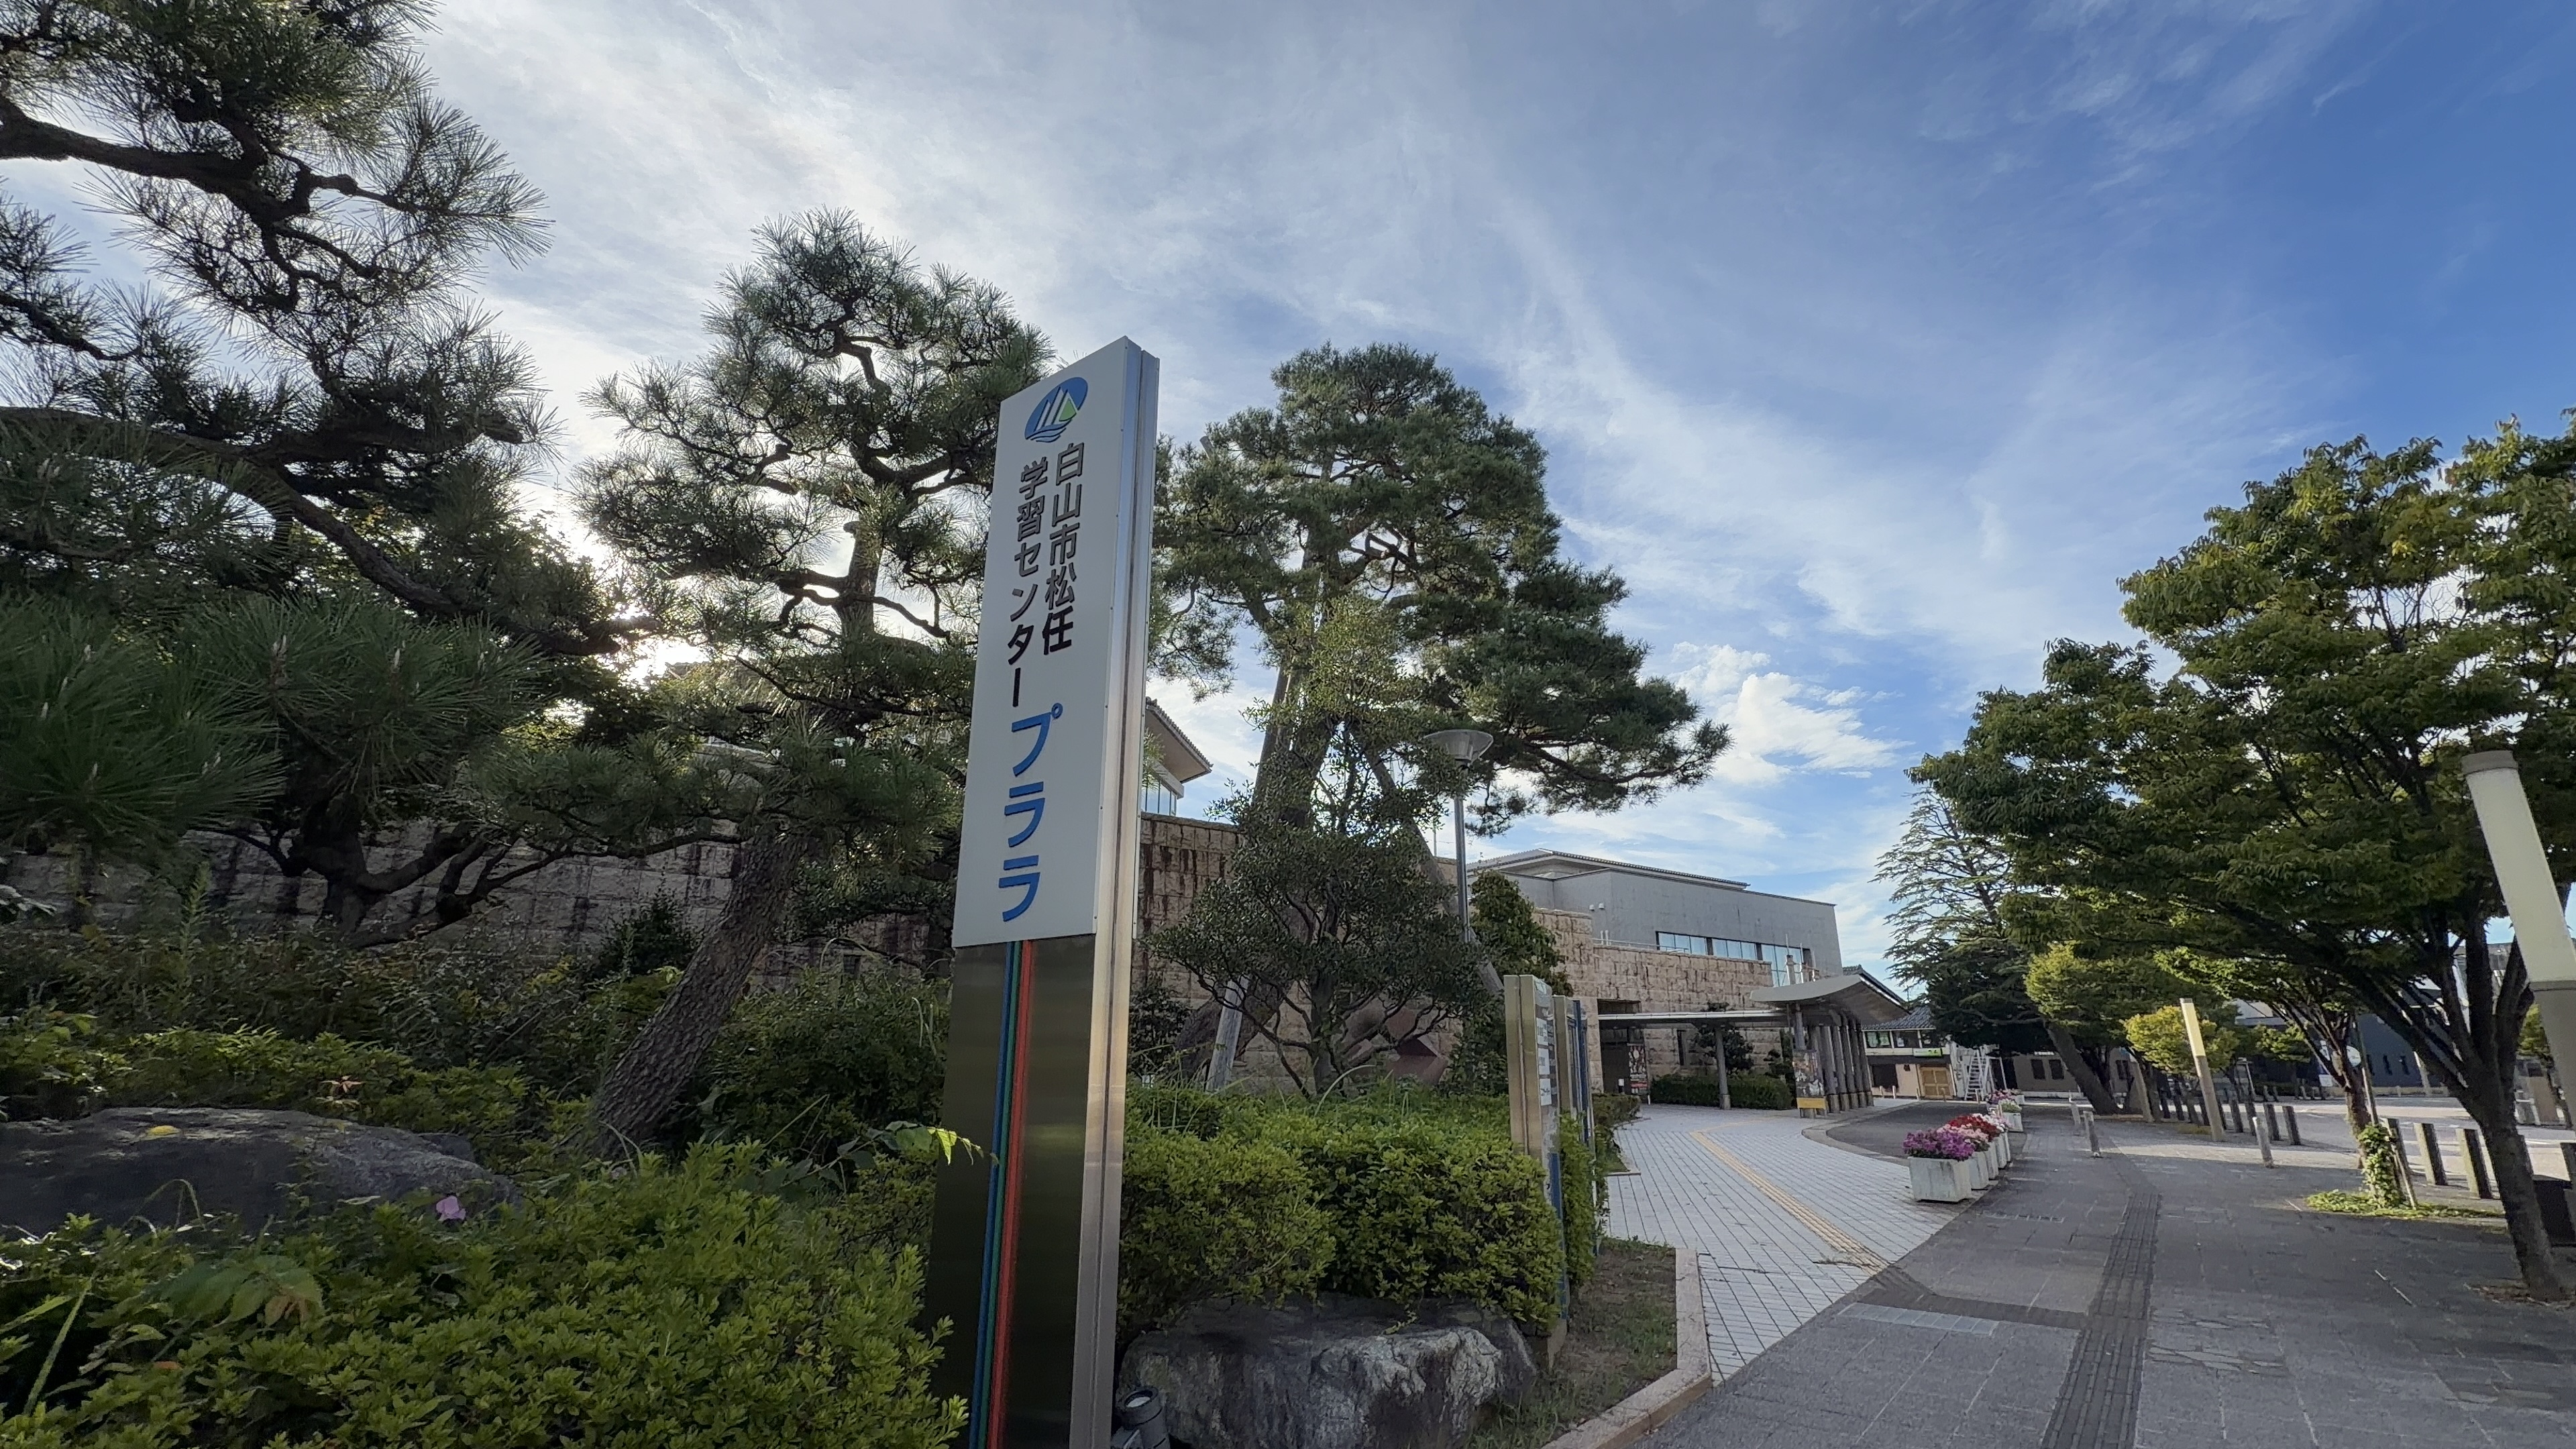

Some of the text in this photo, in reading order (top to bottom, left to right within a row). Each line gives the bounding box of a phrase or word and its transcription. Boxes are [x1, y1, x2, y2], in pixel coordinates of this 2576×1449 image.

[998, 456, 1063, 922] 学習センター プララ
[1042, 442, 1084, 655] 白山市松任
